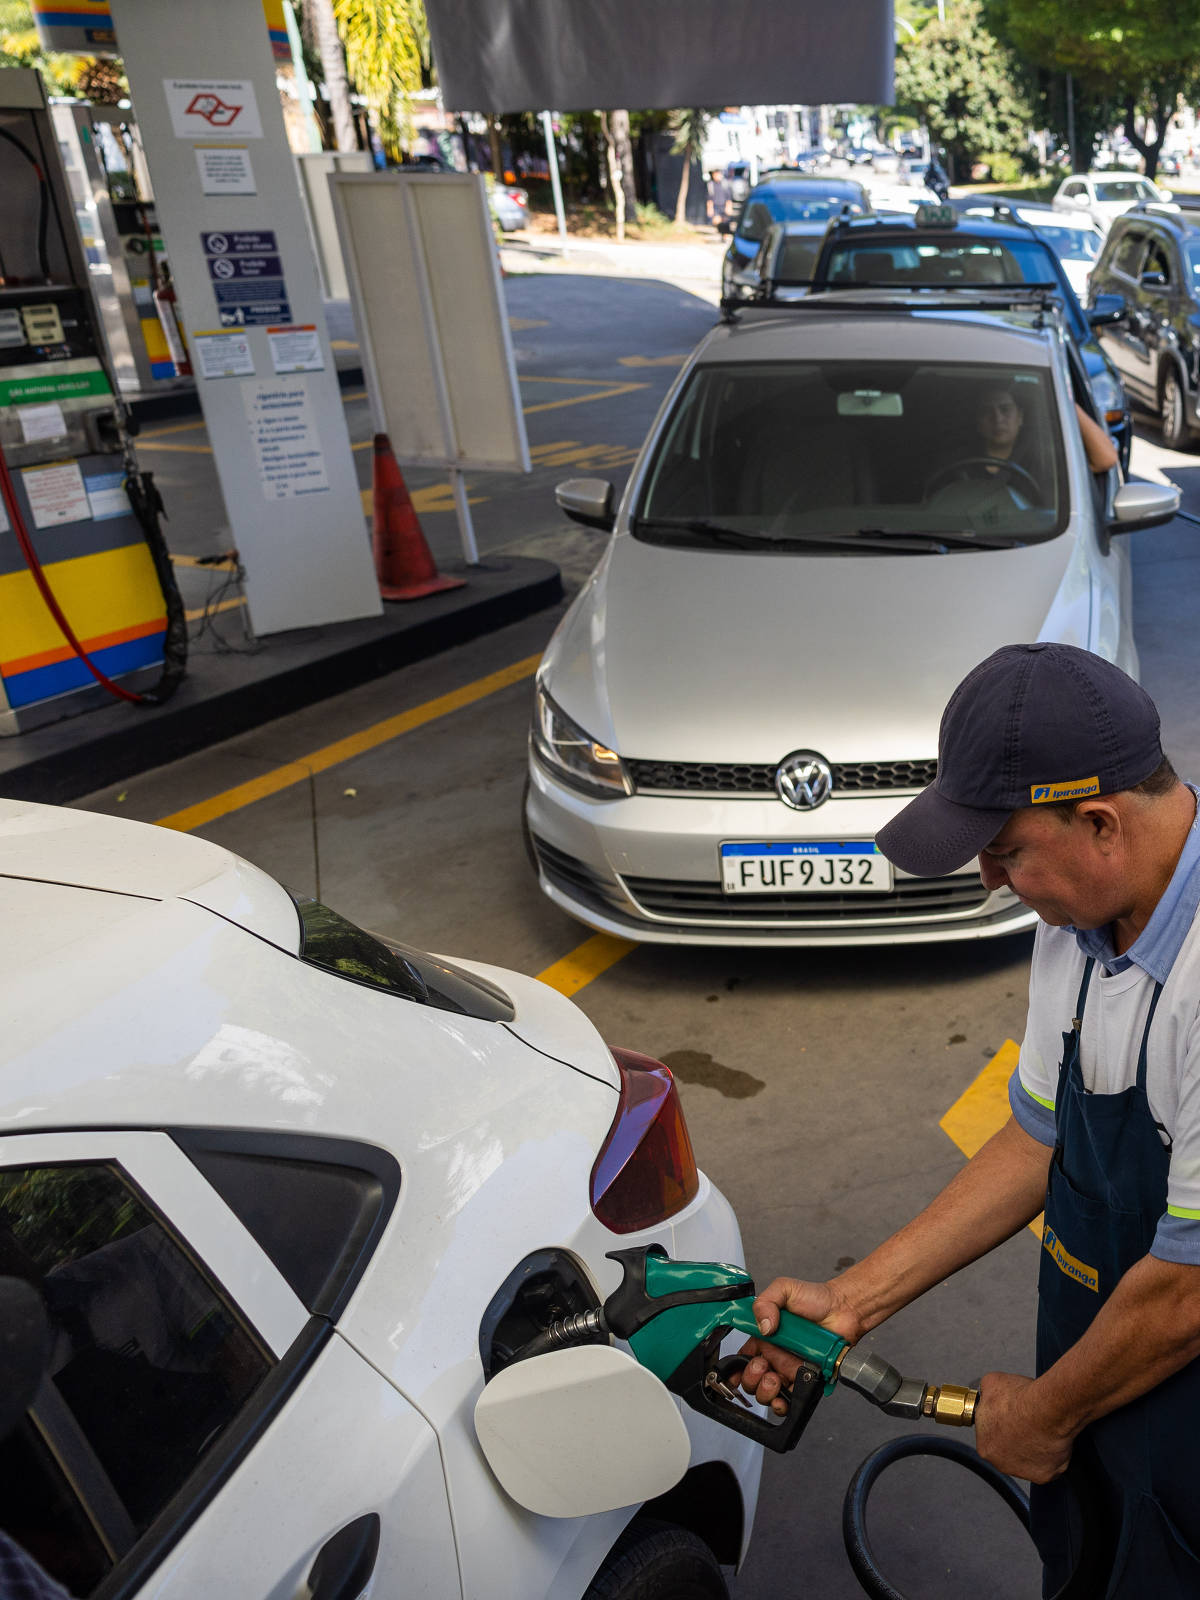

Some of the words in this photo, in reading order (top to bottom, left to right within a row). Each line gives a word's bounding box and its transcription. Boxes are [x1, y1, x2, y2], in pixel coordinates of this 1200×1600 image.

[1053, 785, 1097, 798] Ipiranga
[740, 859, 873, 887] FUF9J32
[1056, 1249, 1096, 1287] Ipiranga
